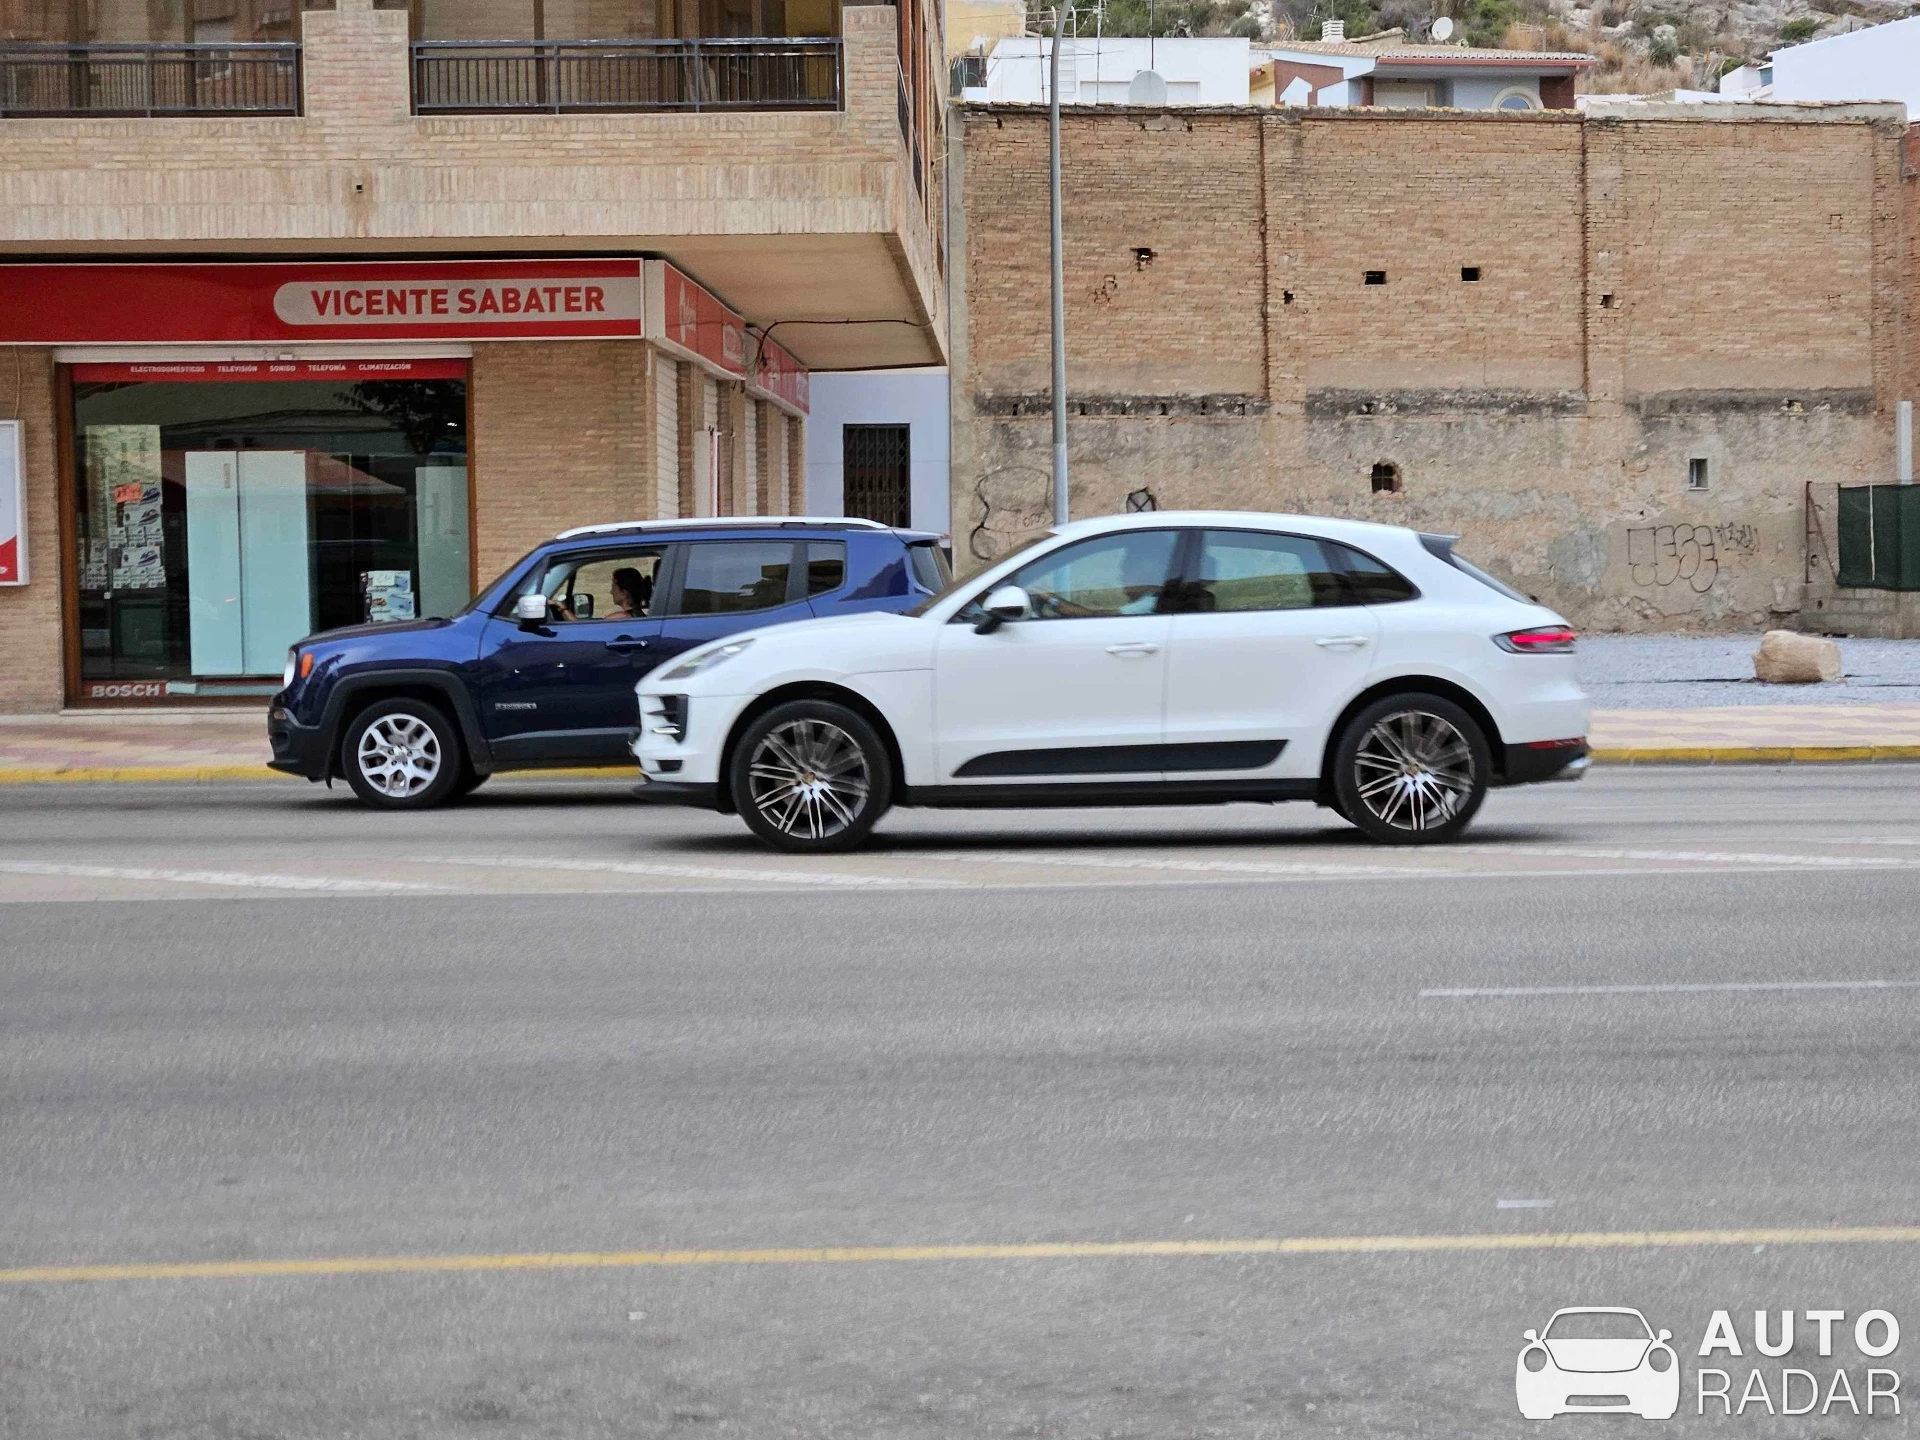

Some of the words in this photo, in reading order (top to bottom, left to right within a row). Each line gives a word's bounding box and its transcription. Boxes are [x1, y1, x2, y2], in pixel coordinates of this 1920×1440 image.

[311, 289, 449, 316] VICENTE
[457, 286, 605, 314] SABATER
[269, 364, 296, 372] SONIDO
[91, 684, 160, 697] BOSCH
